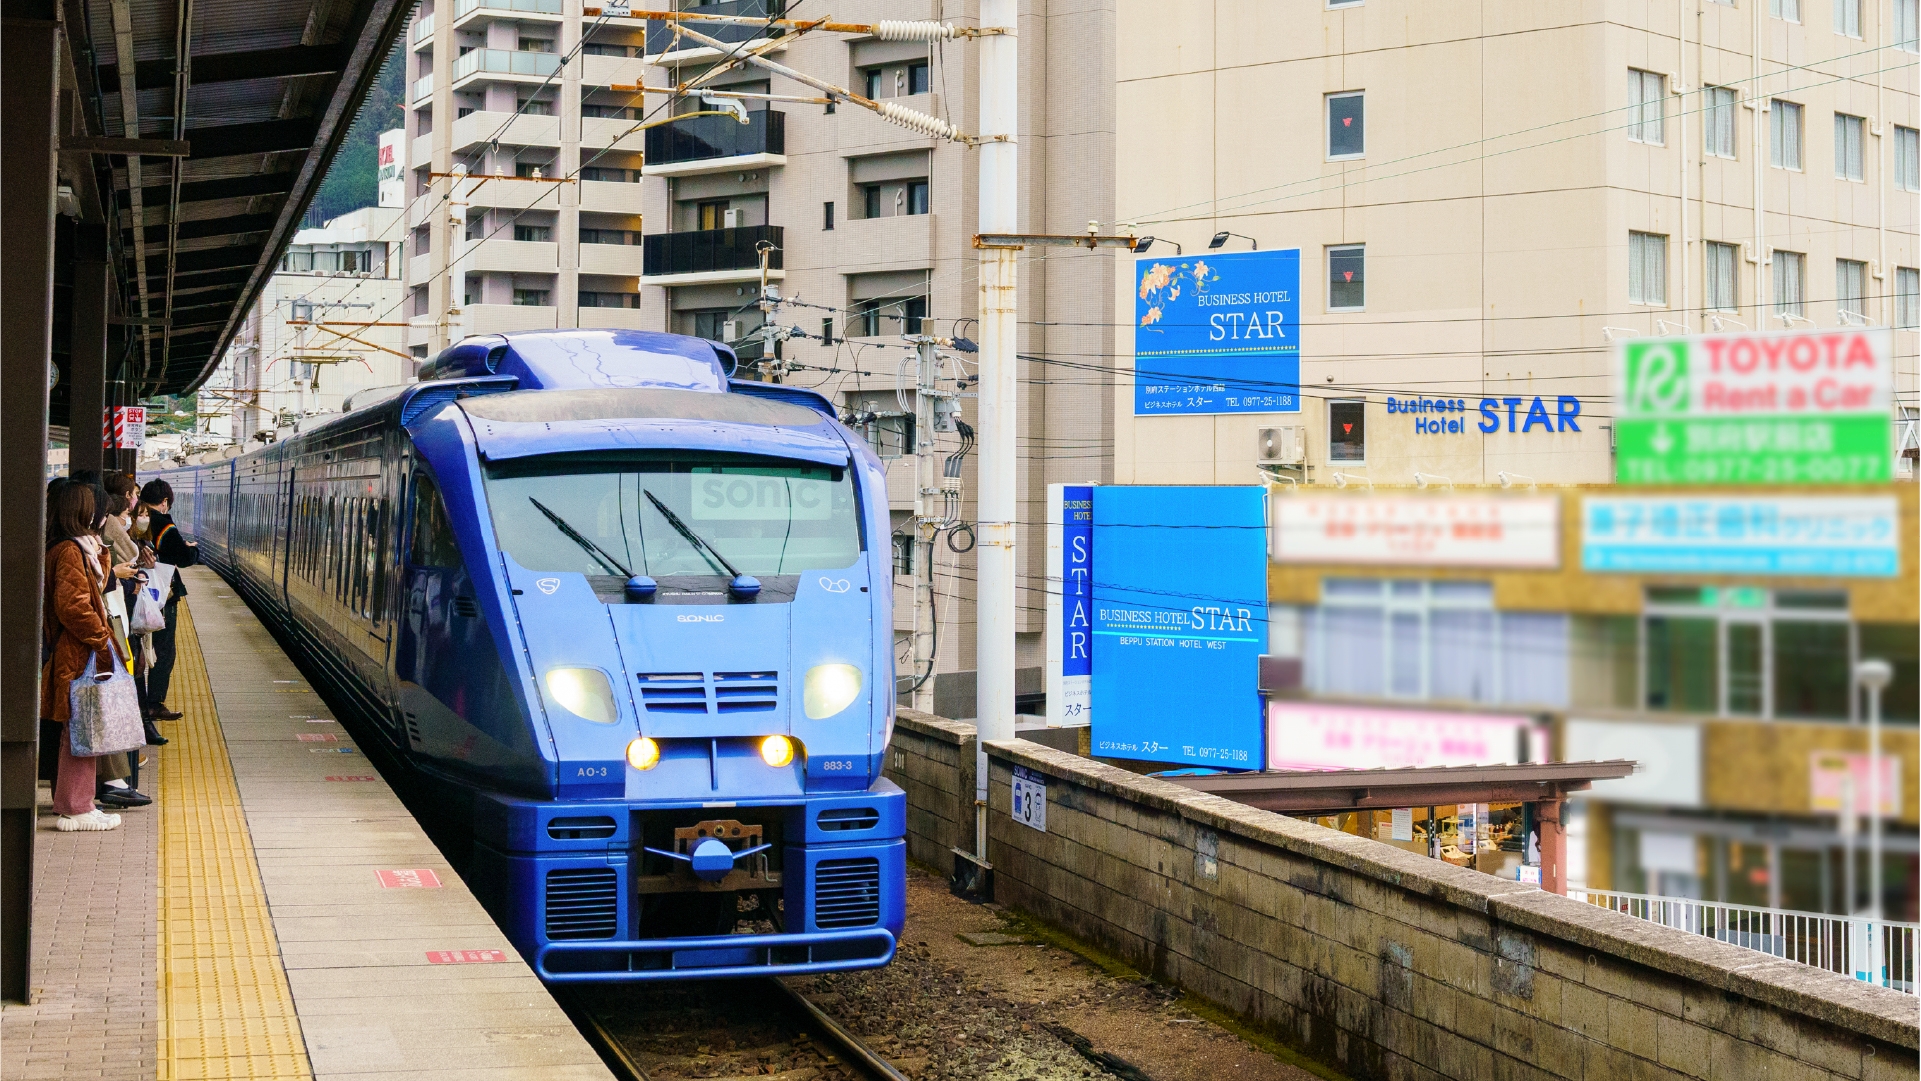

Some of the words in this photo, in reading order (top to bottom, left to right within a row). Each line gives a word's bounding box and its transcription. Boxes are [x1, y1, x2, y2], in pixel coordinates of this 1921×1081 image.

[1198, 292, 1251, 307] BUSINESS
[1254, 290, 1291, 304] HOTEL
[1209, 310, 1286, 341] STAR
[1703, 334, 1875, 374] TOYOTA
[1144, 399, 1183, 409] ビジネスホテル
[1186, 396, 1213, 408] スター
[1226, 397, 1240, 407] TEL
[1243, 396, 1292, 407] 0977-25-1188
[1702, 383, 1777, 411] Rent
[1814, 379, 1875, 410] Car
[1387, 395, 1465, 413] Business
[1478, 395, 1582, 434] STAR
[1415, 416, 1465, 434] Hotel
[1073, 511, 1092, 521] HOTE
[1069, 535, 1090, 660] STAR
[677, 614, 725, 622] SONIC
[1099, 608, 1152, 623] BUSINESS
[1154, 611, 1190, 625] HOTEL
[1191, 606, 1253, 632] STAR
[1119, 636, 1143, 646] BEPPU
[1145, 637, 1175, 647] STATION
[1179, 639, 1203, 649] HOTEL
[1207, 640, 1227, 650] WEST
[1099, 740, 1139, 752] ビジネスホテル
[1141, 741, 1169, 754] スター
[1183, 745, 1197, 757] TEL
[1199, 747, 1248, 762] 0977-25-1188
[577, 766, 607, 777] AO-3
[823, 760, 853, 771] 883-3
[1024, 791, 1032, 823] 3
